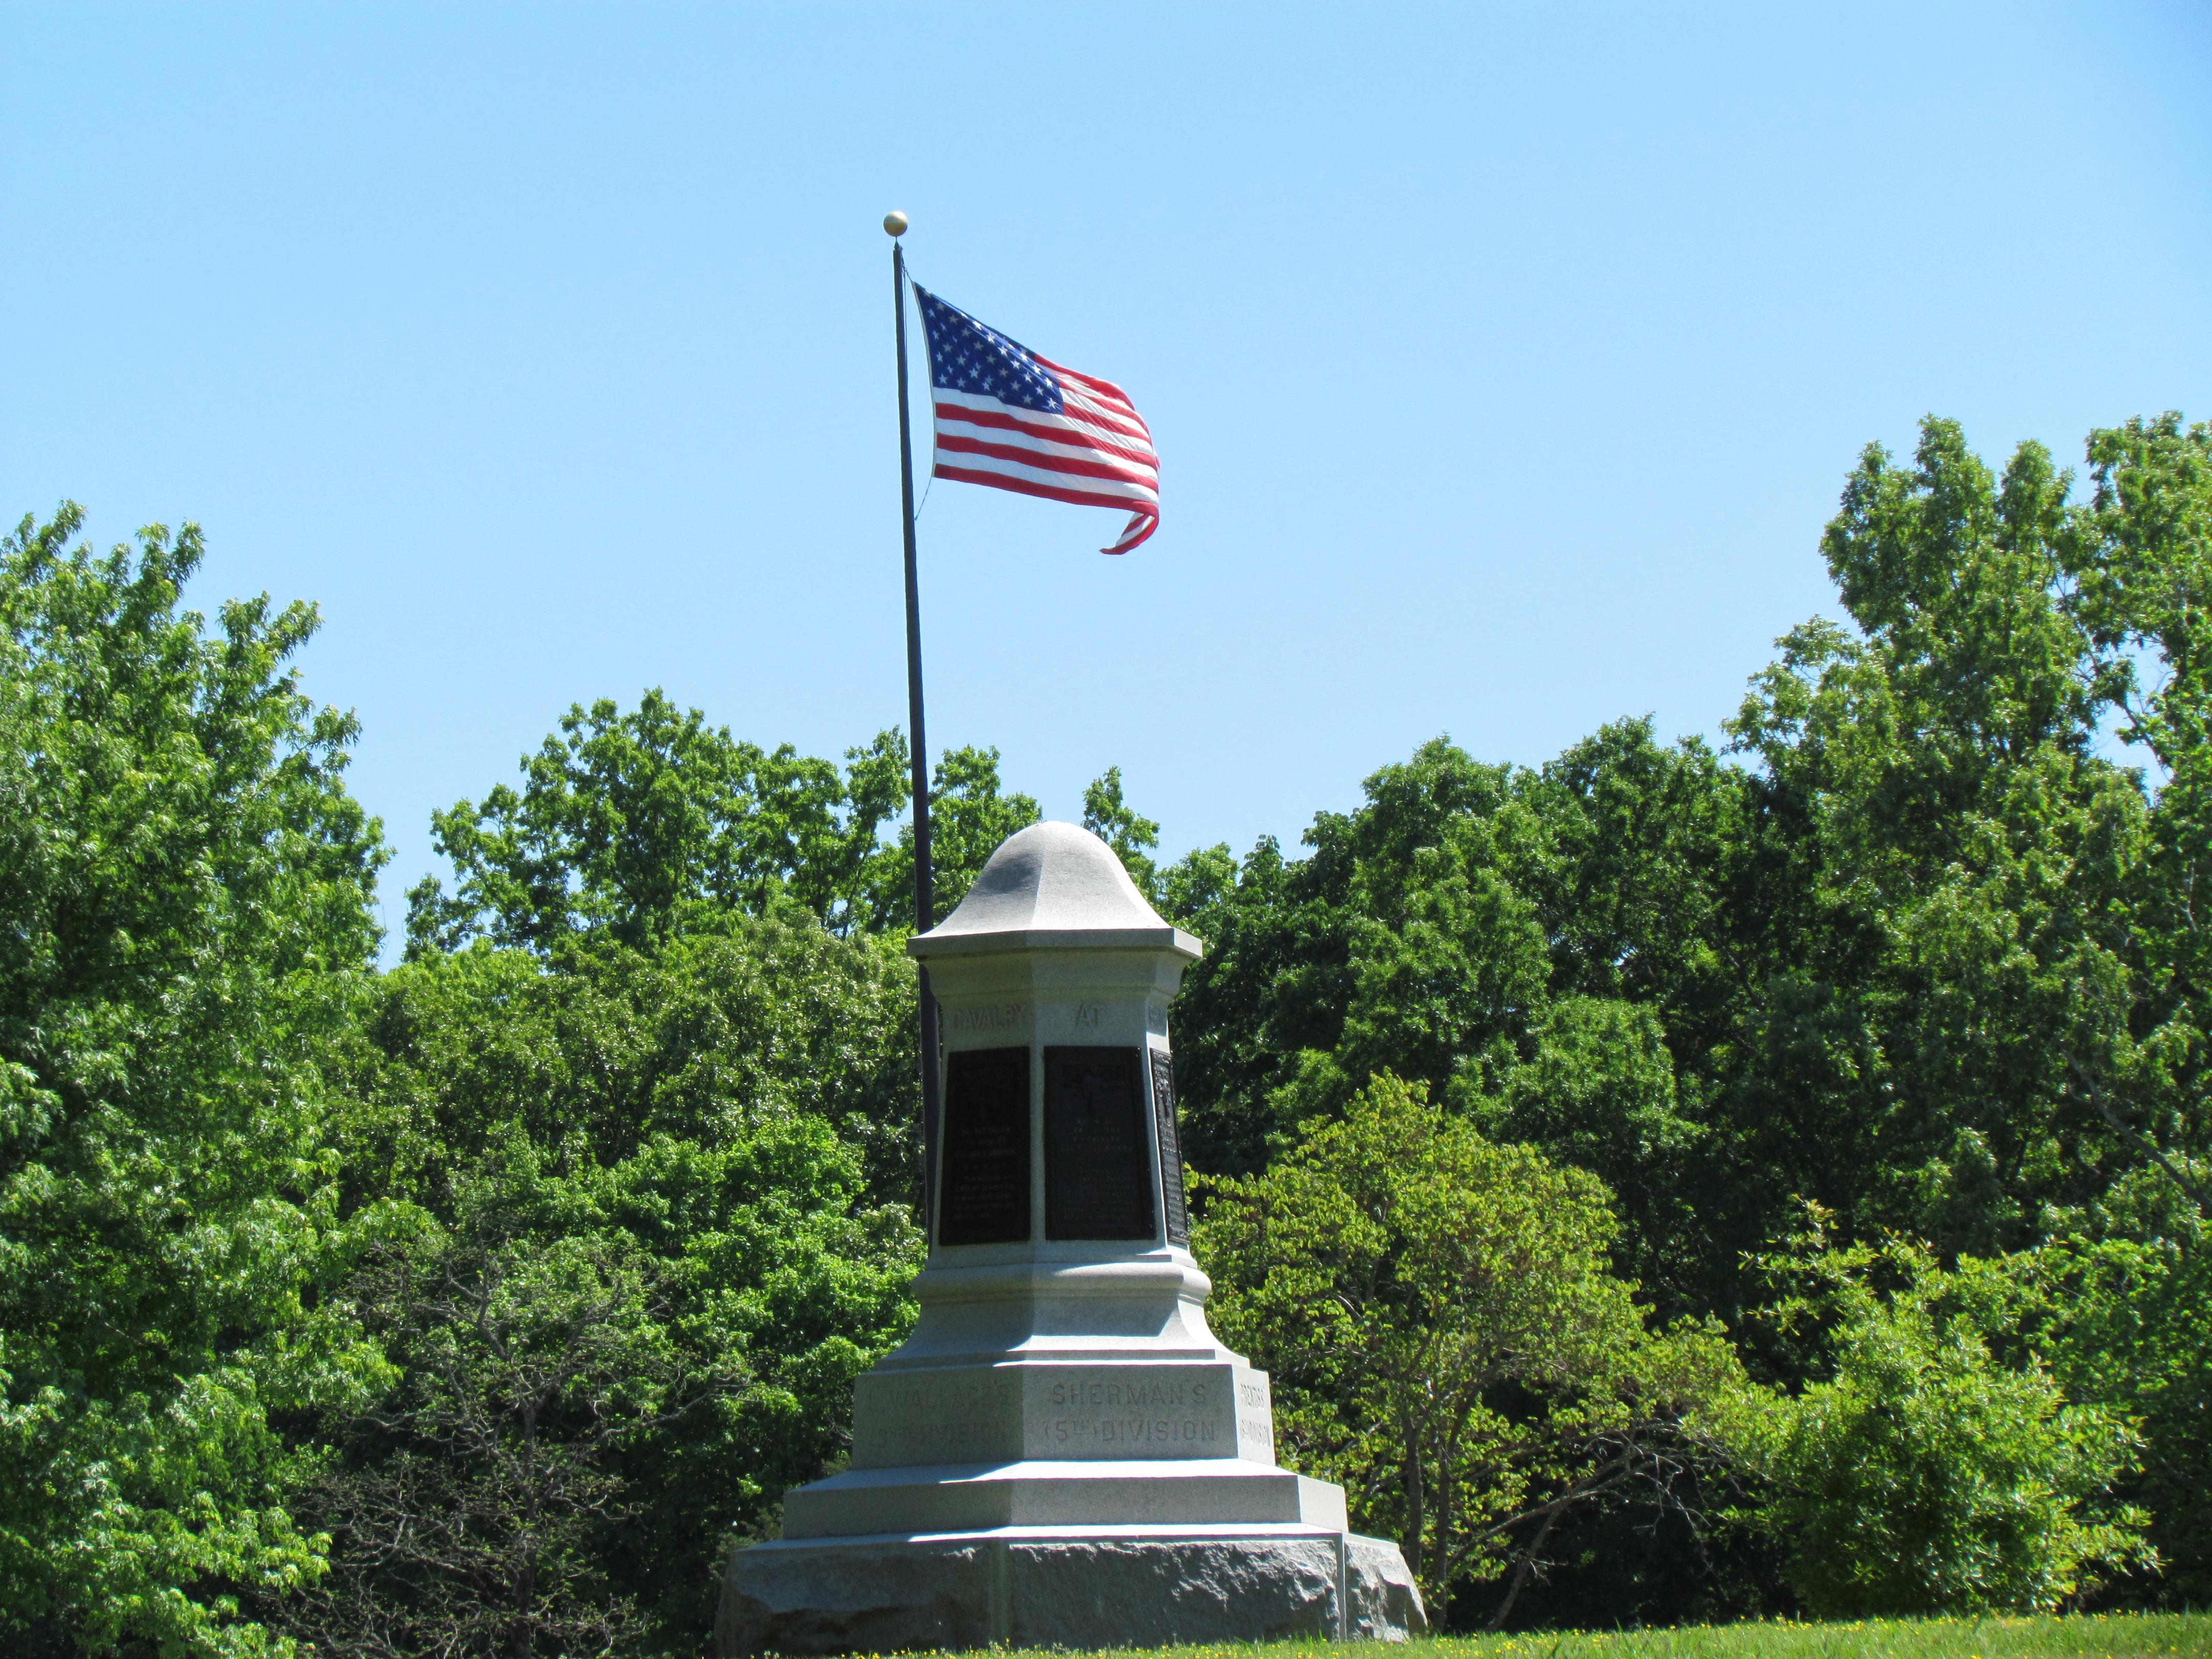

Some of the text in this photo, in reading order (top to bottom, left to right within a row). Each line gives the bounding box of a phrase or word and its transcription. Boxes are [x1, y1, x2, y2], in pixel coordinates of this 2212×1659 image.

[952, 1003, 1104, 1030] CAVALRY AT
[1052, 1382, 1206, 1405] SHERMAN'S
[1101, 1420, 1216, 1441] DIVISION
